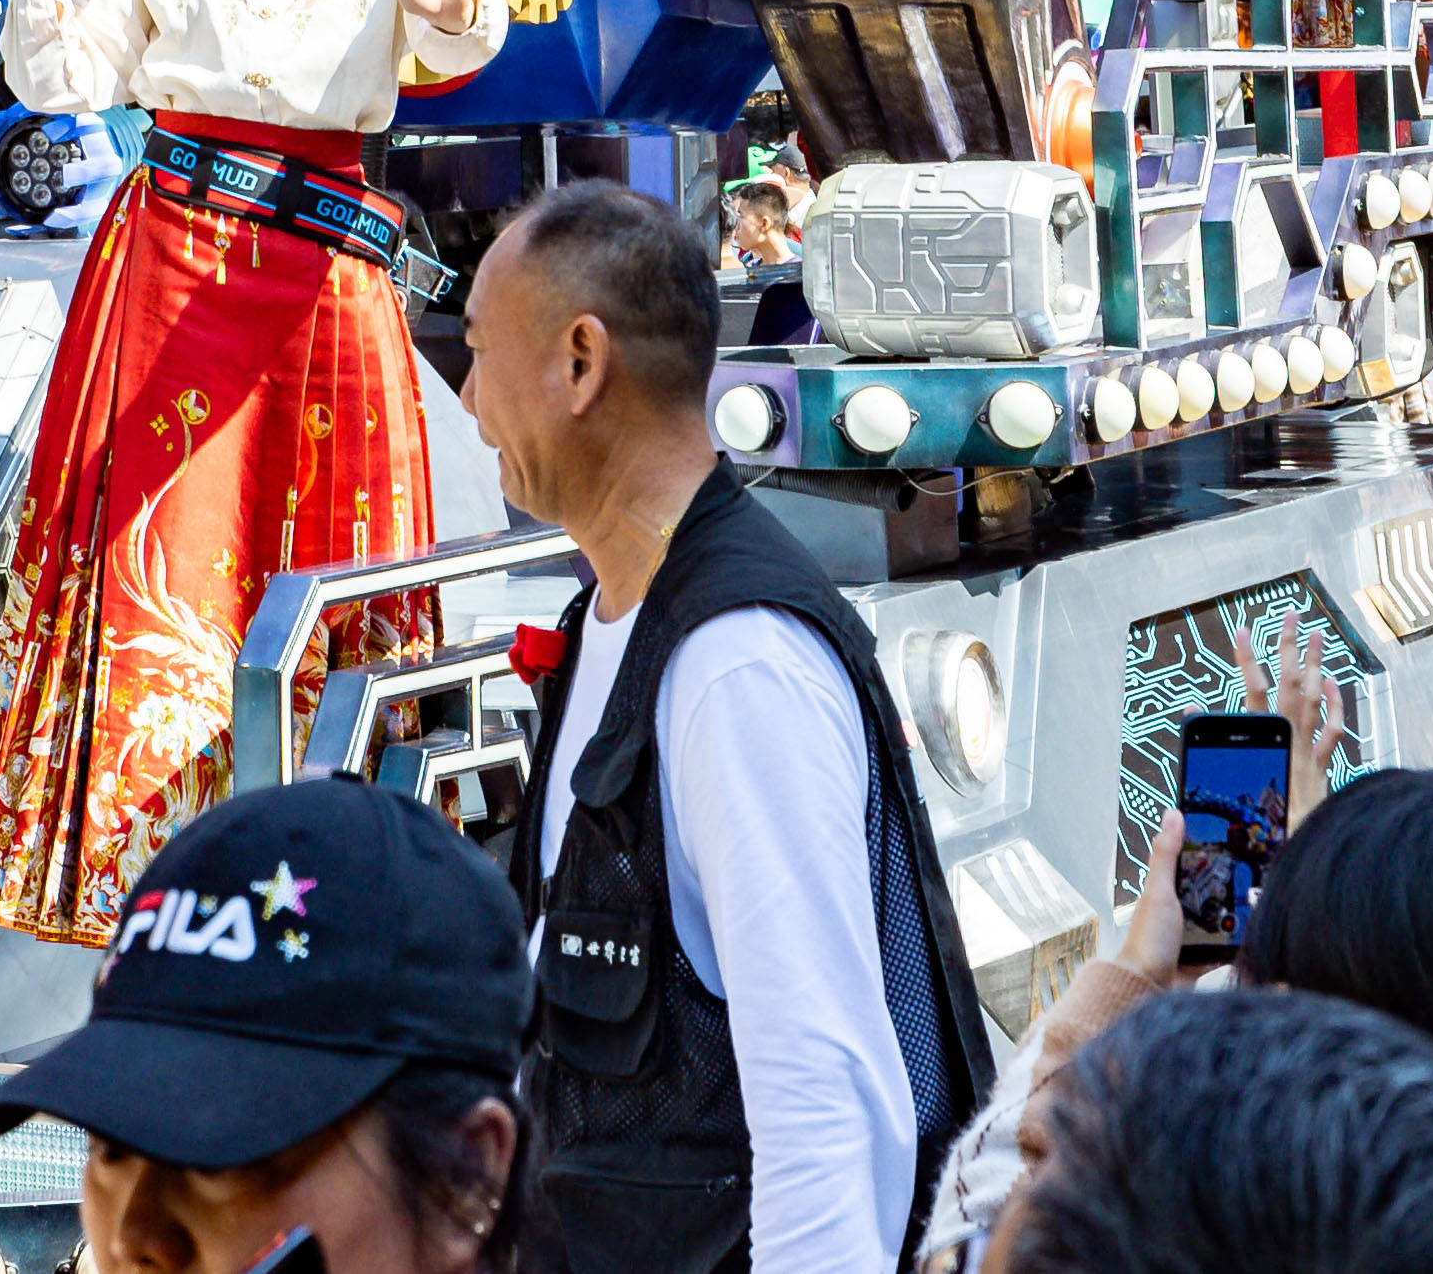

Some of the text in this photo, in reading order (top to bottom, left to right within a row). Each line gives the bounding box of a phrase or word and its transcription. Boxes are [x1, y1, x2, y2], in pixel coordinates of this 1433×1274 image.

[169, 146, 259, 191] GOMUD
[316, 198, 391, 245] GOLMUD
[118, 887, 257, 962] FILA
